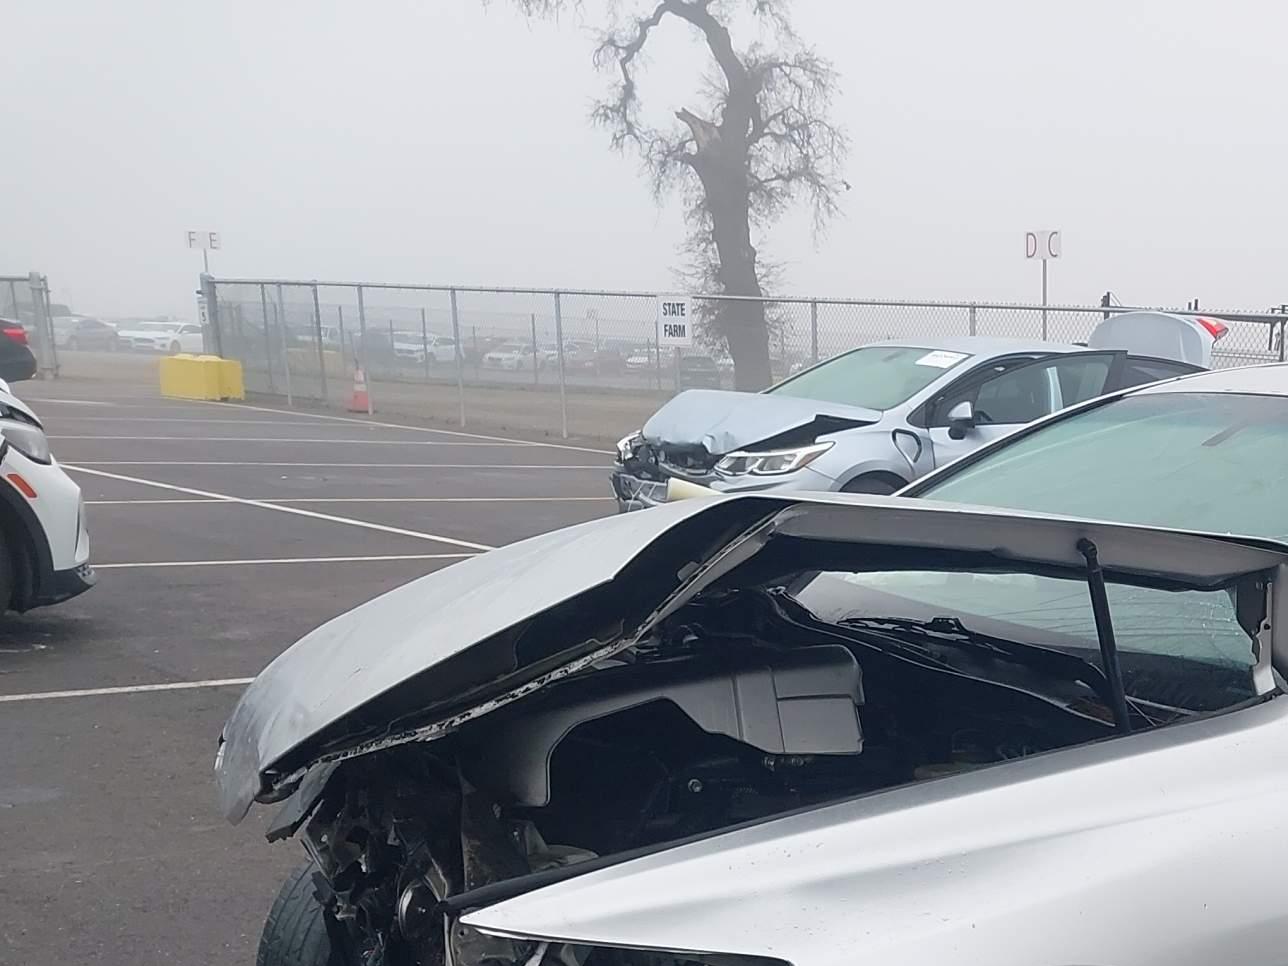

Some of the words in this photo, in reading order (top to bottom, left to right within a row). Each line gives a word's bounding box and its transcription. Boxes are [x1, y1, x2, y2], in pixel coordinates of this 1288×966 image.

[188, 231, 197, 248] F
[209, 232, 218, 249] E
[1026, 232, 1037, 258] D
[1048, 231, 1058, 257] C
[662, 302, 686, 316] STATE
[663, 324, 686, 338] FARM
